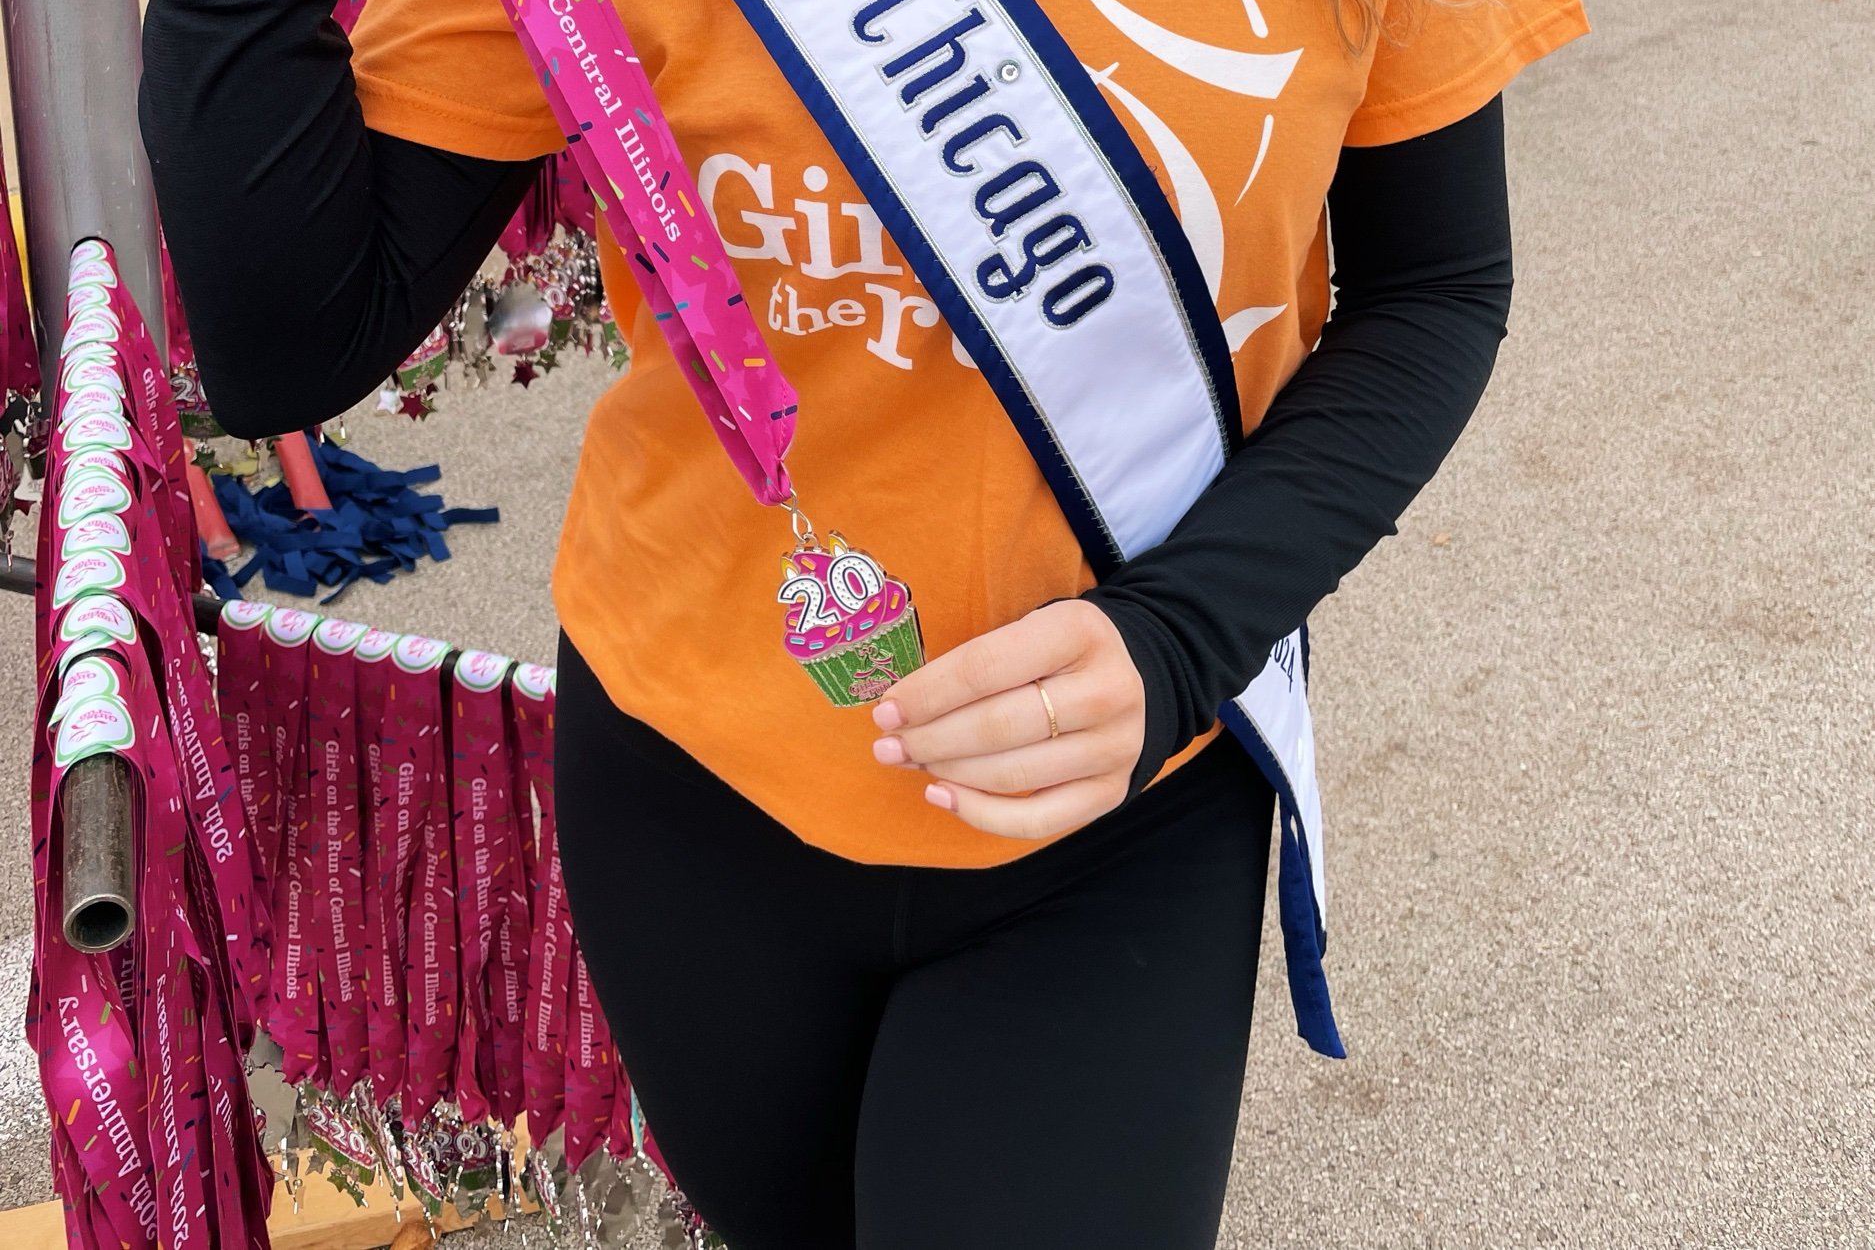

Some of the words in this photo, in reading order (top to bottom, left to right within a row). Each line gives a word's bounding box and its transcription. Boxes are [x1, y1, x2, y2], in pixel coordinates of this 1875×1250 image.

[614, 118, 682, 243] Illinois
[697, 153, 918, 283] Gir
[767, 277, 867, 336] the
[143, 367, 159, 410] Girls
[170, 375, 207, 402] 2
[777, 552, 885, 634] 20
[1269, 636, 1295, 694] 024
[236, 712, 252, 750] Girls
[239, 754, 250, 775] on
[325, 740, 340, 781] Girls
[240, 777, 255, 803] the
[326, 785, 337, 805] on
[398, 762, 414, 806] Girls
[471, 777, 488, 821] Girls
[203, 802, 233, 863] 20th
[287, 823, 298, 857] Run
[327, 811, 341, 836] the
[398, 809, 409, 832] on
[424, 824, 436, 849] the
[473, 823, 486, 845] on
[328, 839, 342, 873] Run
[397, 834, 411, 860] the
[475, 847, 490, 874] the
[288, 861, 301, 879] of
[328, 877, 343, 894] of
[425, 851, 438, 888] Run
[288, 881, 302, 939] Central
[424, 892, 438, 910] of
[476, 875, 492, 911] Run
[547, 884, 561, 919] Run
[330, 897, 349, 949] Central
[423, 912, 439, 969] Central
[545, 922, 557, 942] of
[286, 943, 301, 999] Illinois
[336, 951, 354, 1002] Illinois
[541, 942, 556, 999] Central
[424, 972, 440, 1026] Illinois
[505, 969, 521, 1023] Illinois
[537, 999, 552, 1052] Illinois
[580, 1011, 595, 1068] Illinois
[58, 996, 142, 1179] Anniversary
[156, 973, 181, 1168] Anniversary
[130, 1173, 158, 1240] 20th
[171, 1170, 190, 1250] 20th
